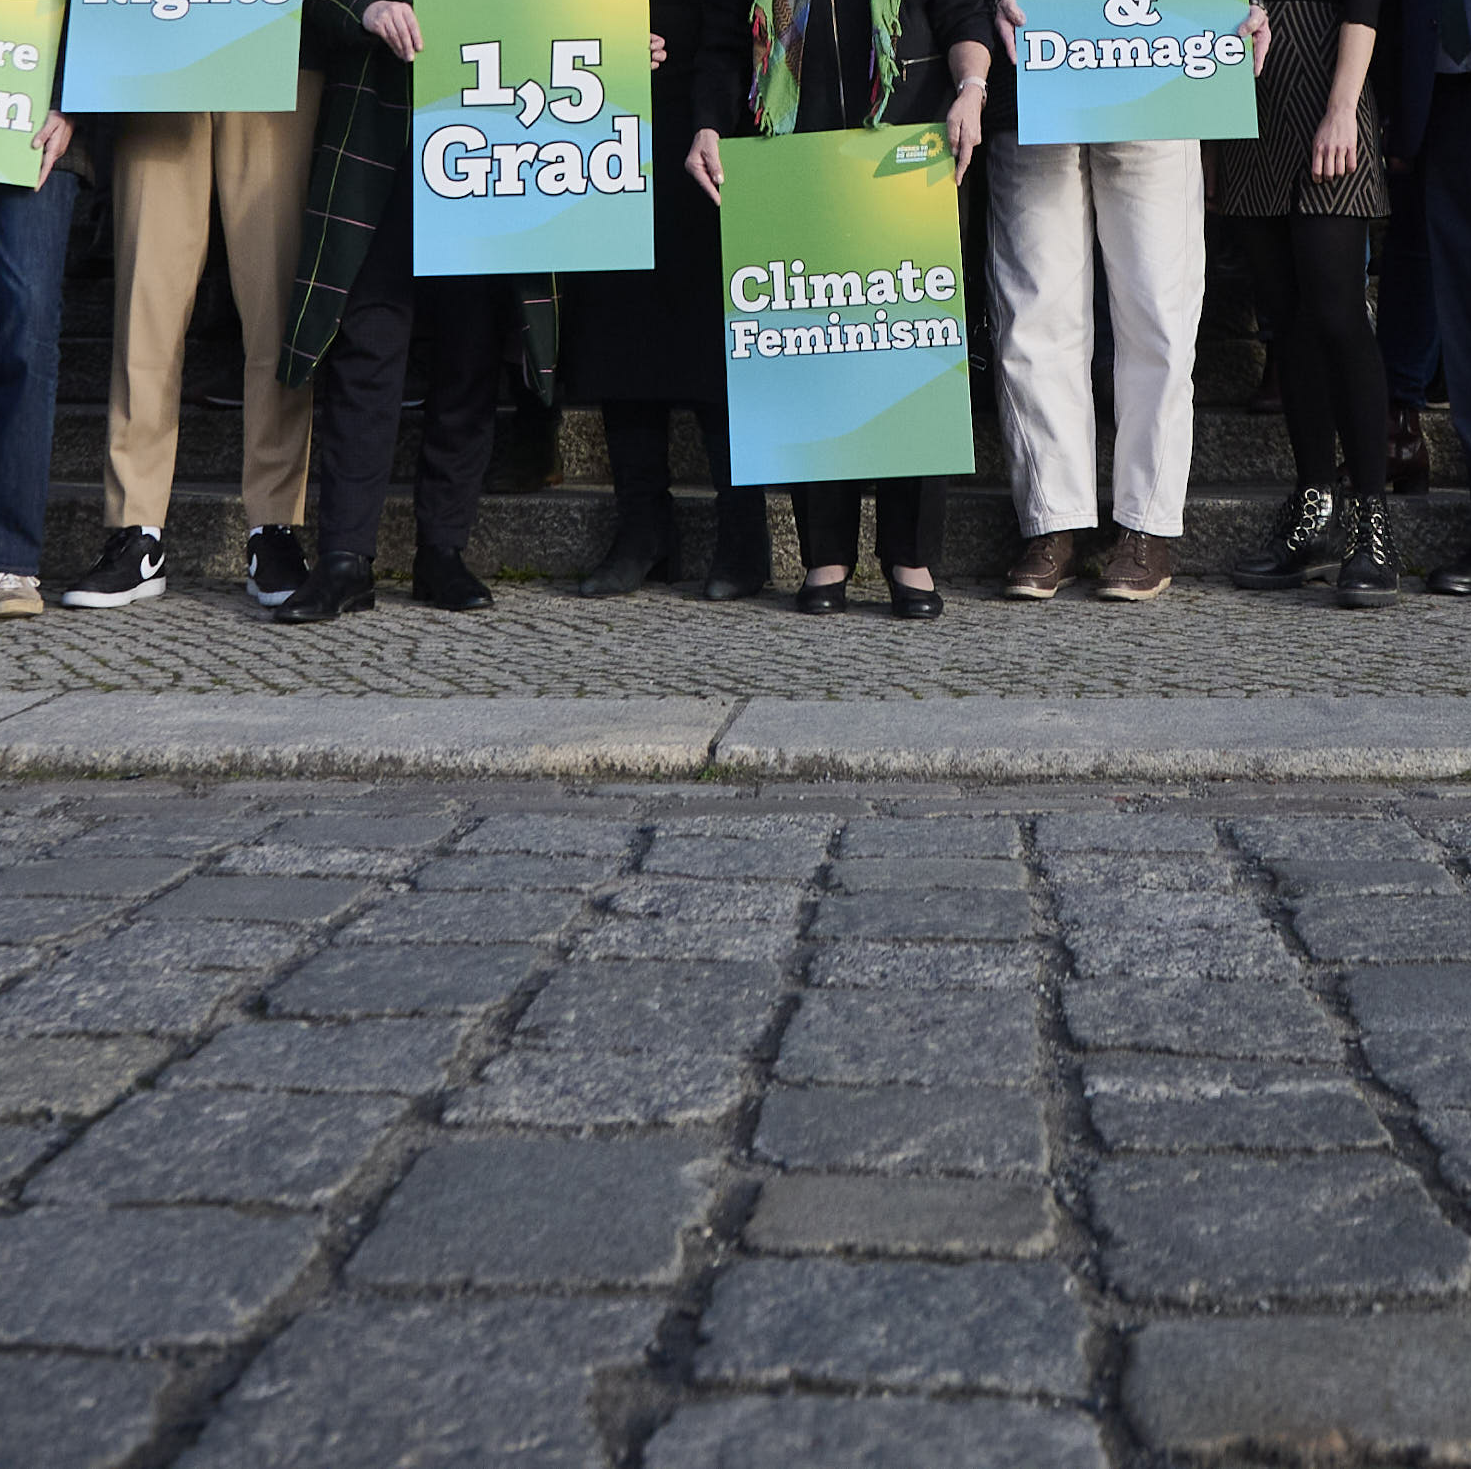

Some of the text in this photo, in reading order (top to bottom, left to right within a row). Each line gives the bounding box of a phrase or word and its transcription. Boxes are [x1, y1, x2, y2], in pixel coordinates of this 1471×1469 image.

[1023, 28, 1246, 80] Damage
[460, 39, 605, 127] 1,5
[422, 115, 646, 199] Grad
[729, 258, 957, 314] Climate
[729, 308, 962, 360] Feminism
